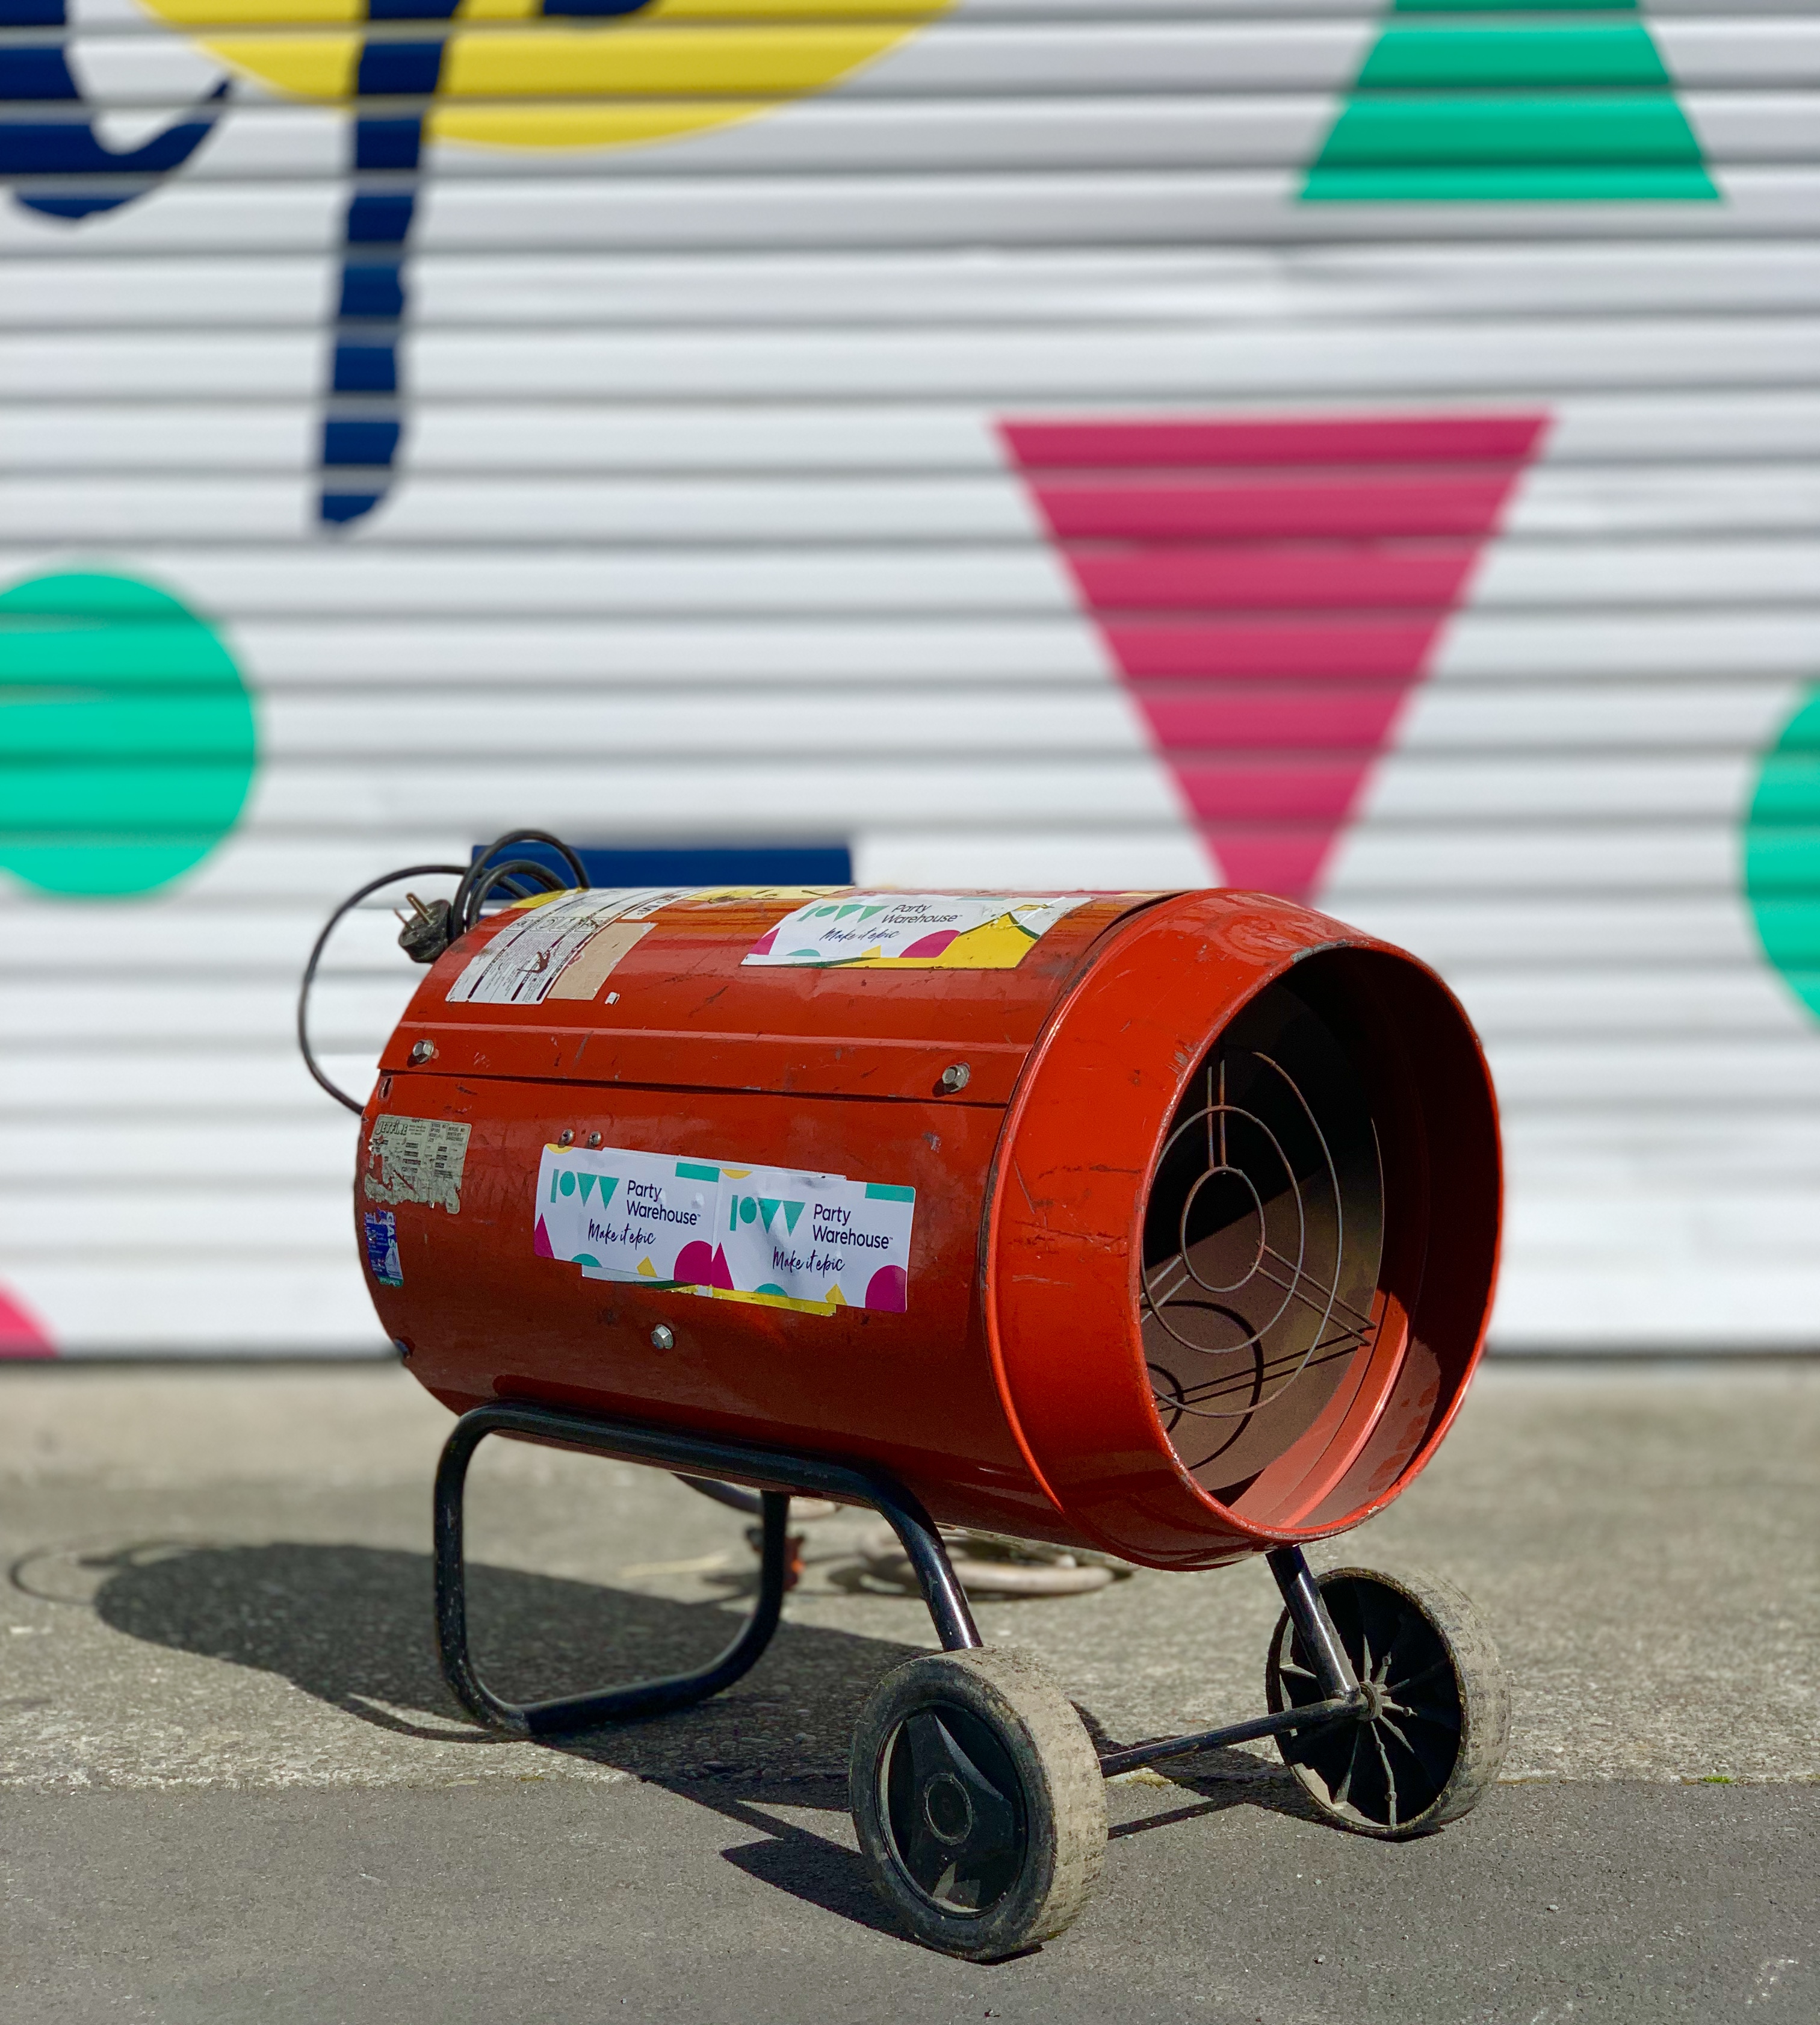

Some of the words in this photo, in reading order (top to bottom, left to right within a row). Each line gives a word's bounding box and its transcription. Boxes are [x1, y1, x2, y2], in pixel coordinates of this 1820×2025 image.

[881, 913, 958, 924] Warehouse
[891, 904, 932, 914] Party
[819, 927, 859, 943] Make
[627, 1180, 662, 1202] Party
[627, 1199, 698, 1226] Warehouse
[813, 1203, 851, 1226] Party
[588, 1218, 619, 1245] Make
[620, 1223, 631, 1245] it
[630, 1227, 656, 1250] epic
[812, 1224, 890, 1250] Warehouse
[773, 1246, 804, 1273] Make
[806, 1249, 819, 1273] it
[816, 1253, 846, 1279] epic
